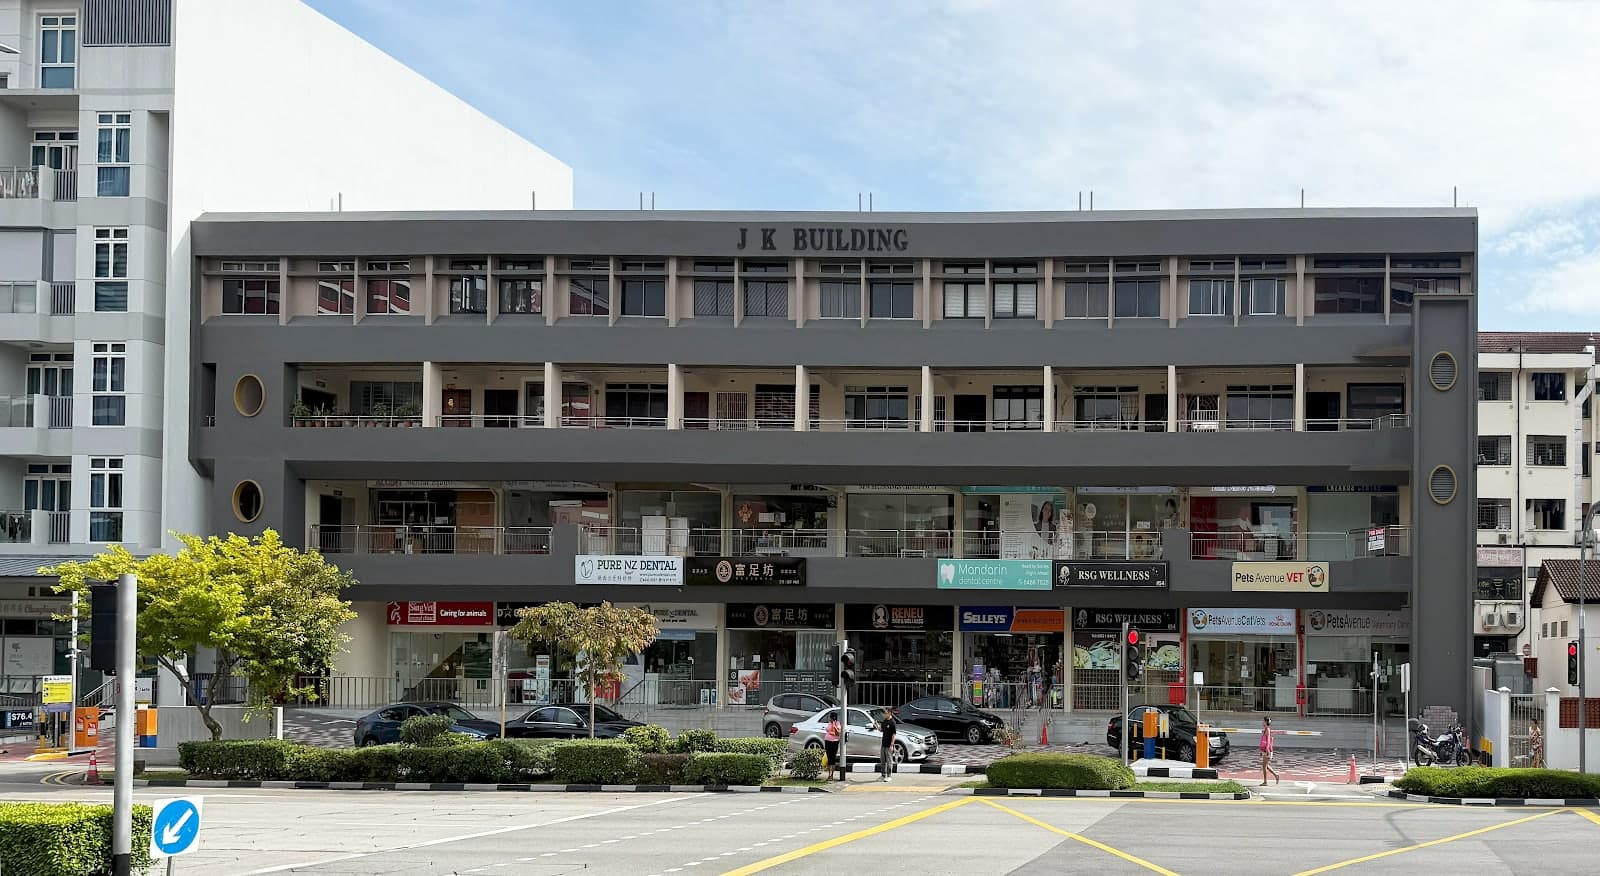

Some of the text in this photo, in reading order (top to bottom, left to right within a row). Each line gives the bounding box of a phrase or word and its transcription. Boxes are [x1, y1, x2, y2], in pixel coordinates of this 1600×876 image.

[737, 228, 908, 251] J K BUILDING
[597, 559, 677, 571] PURE NZ DENTAL
[735, 563, 774, 577] 富足坊
[958, 563, 1008, 575] Mandarin
[959, 576, 980, 585] dental
[1078, 570, 1150, 581] RSG WELLNESS
[1235, 572, 1305, 583] Pets Avenue VET
[440, 609, 487, 618] Caring for animals
[771, 608, 808, 621] 富足坊
[892, 607, 924, 618] RENEU
[963, 611, 1006, 624] SELLEYS
[1095, 613, 1162, 624] RSG WELLNESS
